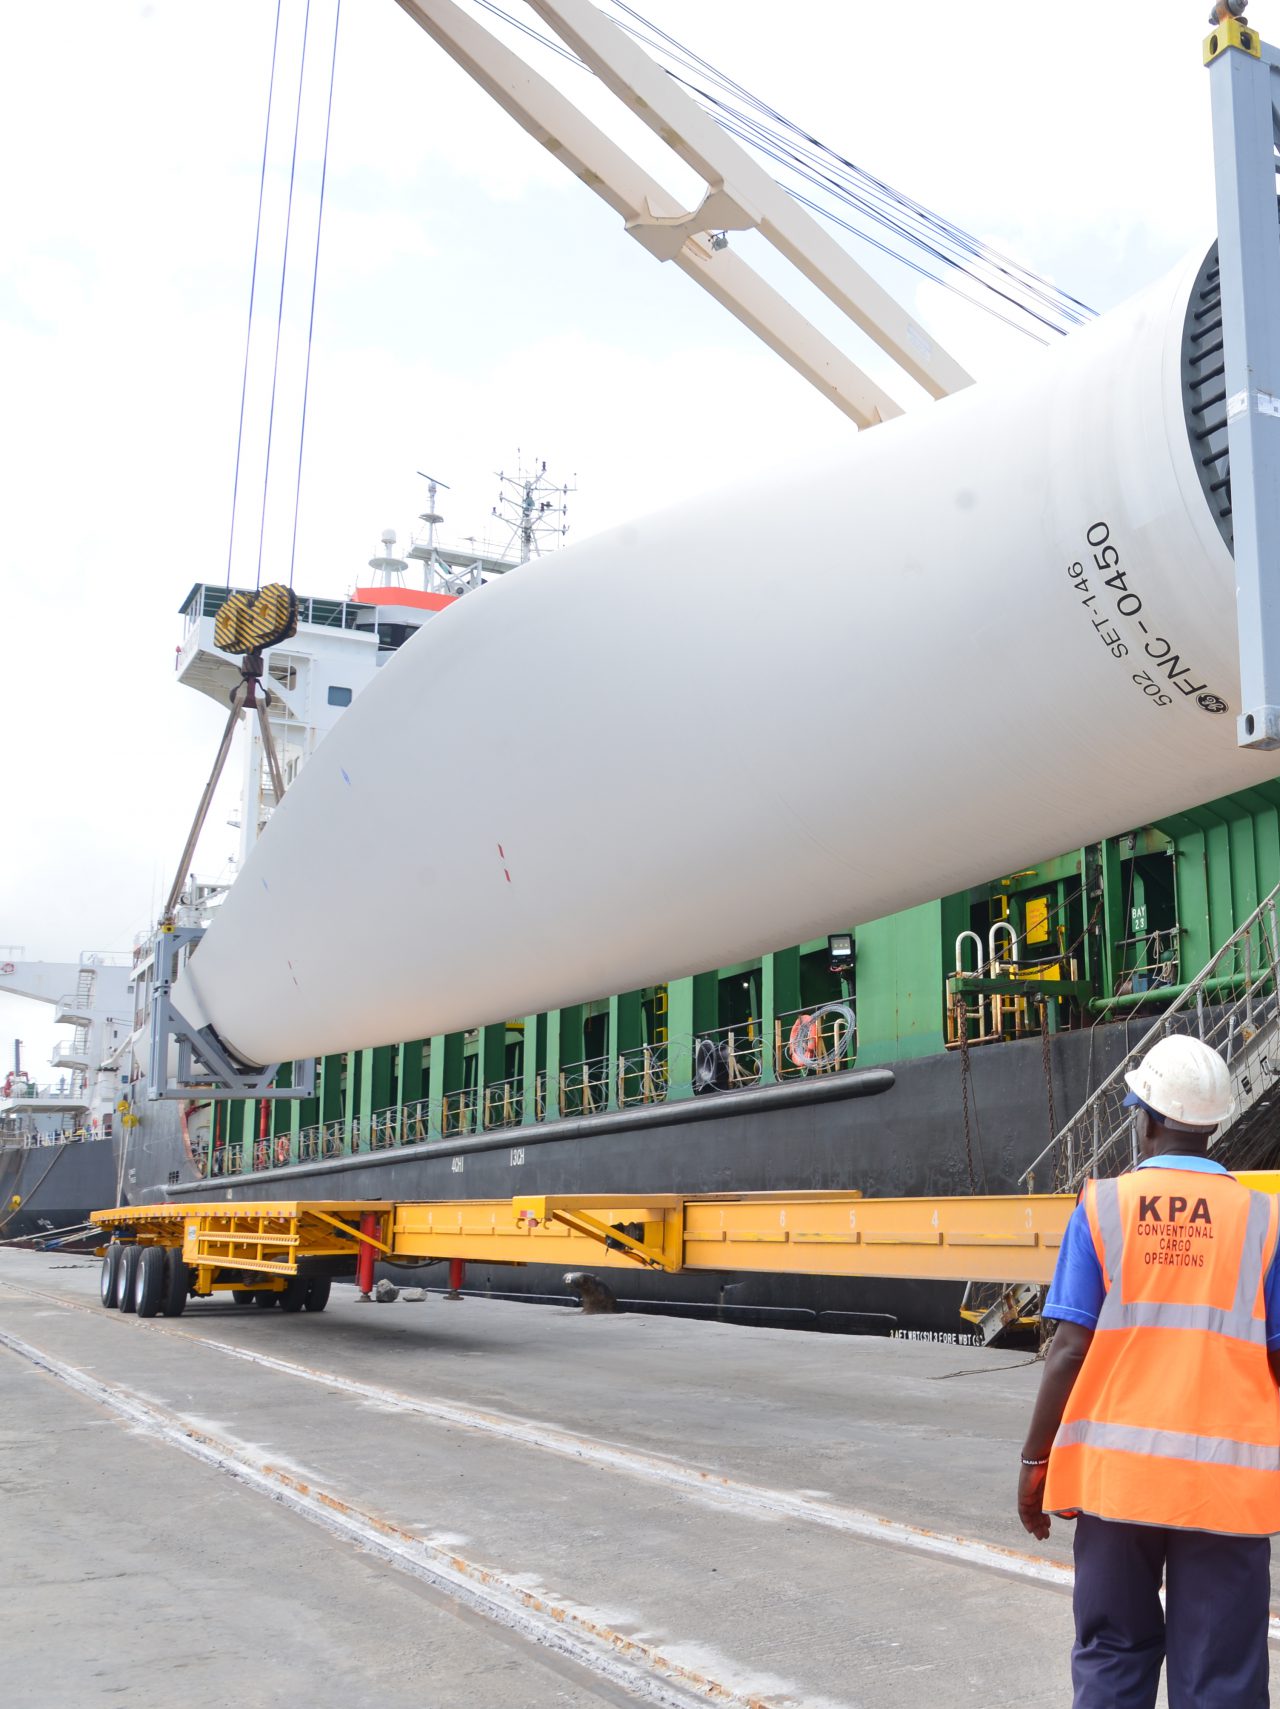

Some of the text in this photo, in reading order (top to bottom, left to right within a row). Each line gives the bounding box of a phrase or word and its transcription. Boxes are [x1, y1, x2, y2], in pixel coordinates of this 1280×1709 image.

[1086, 521, 1208, 696] FNC-0450
[1067, 561, 1173, 707] 502 SET-146
[1131, 906, 1146, 919] BAY
[1135, 917, 1145, 930] 23
[1139, 1195, 1211, 1224] KPA
[1025, 1207, 1032, 1229] 3
[1137, 1223, 1214, 1239] CONVENTIONAL
[1159, 1238, 1191, 1252] CARGO
[1144, 1252, 1204, 1268] OPERATIONS
[939, 1332, 957, 1344] FORE
